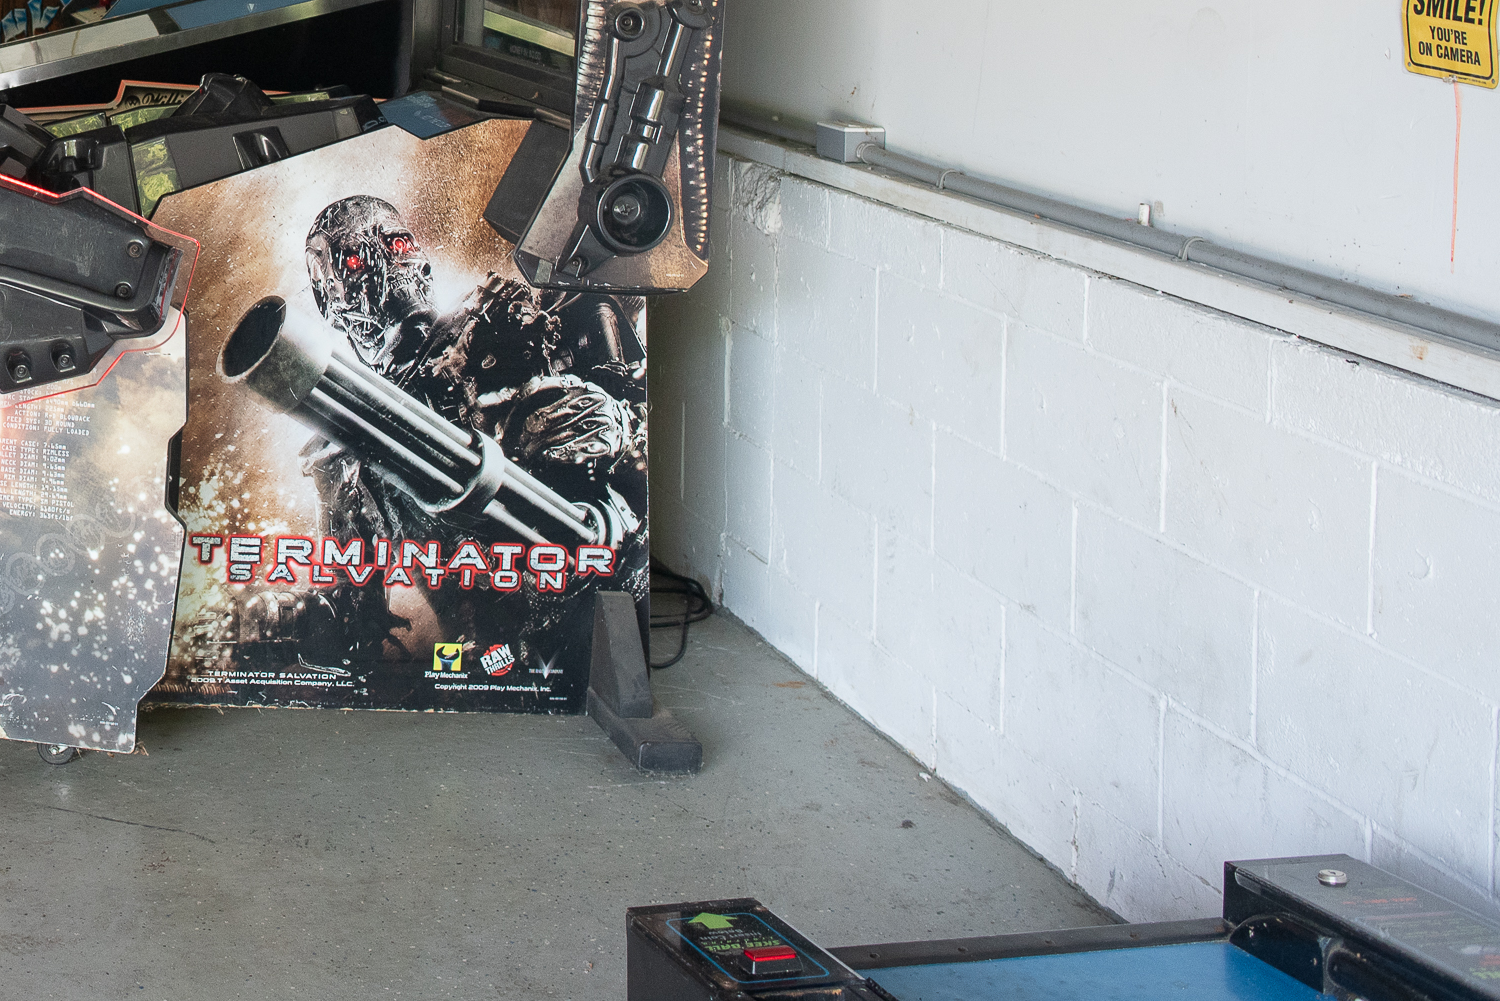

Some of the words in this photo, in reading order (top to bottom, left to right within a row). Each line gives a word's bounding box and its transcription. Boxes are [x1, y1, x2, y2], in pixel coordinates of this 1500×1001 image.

[1429, 25, 1468, 46] YOU'RE
[1418, 41, 1433, 56] ON
[1436, 44, 1481, 66] CAMERA
[3, 422, 40, 431] CONDITION:
[67, 428, 90, 436] LOADED
[43, 449, 70, 457] RIMLESS
[1, 466, 16, 474] BASE
[19, 475, 38, 483] DIAM:
[11, 481, 37, 489] LENGTH:
[11, 488, 37, 497] LENGTH:
[3, 502, 36, 510] VELOCITY:
[52, 500, 75, 508] PISTOL
[9, 509, 36, 517] ENERGY:
[190, 535, 615, 575] TERMINATOR
[228, 563, 565, 590] SALVATION
[480, 643, 512, 669] RAW
[484, 654, 516, 676] THRILLS
[208, 670, 275, 679] TERMINATOR
[279, 672, 337, 680] SALVATION
[424, 670, 440, 680] Play
[440, 671, 468, 679] Mechanix
[250, 678, 293, 686] Acquisition
[434, 683, 467, 691] Copyright
[490, 684, 506, 693] Play
[704, 943, 741, 952] BALL
